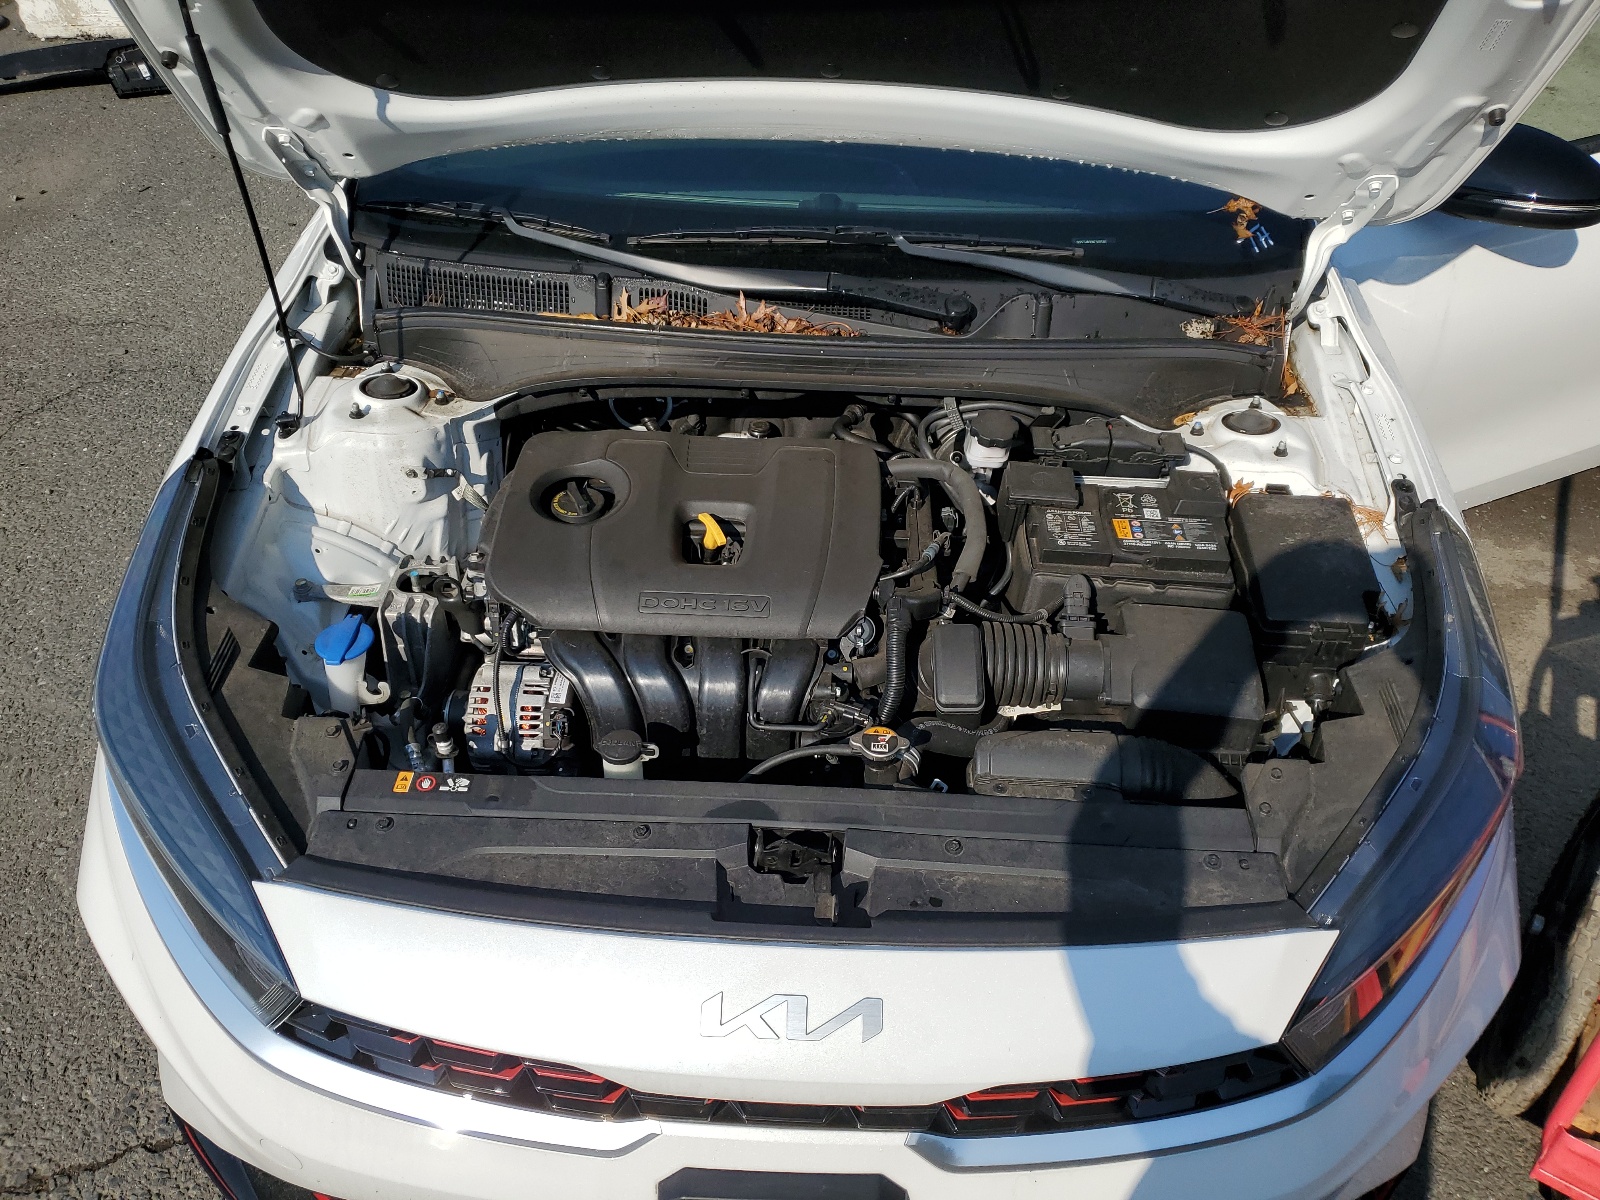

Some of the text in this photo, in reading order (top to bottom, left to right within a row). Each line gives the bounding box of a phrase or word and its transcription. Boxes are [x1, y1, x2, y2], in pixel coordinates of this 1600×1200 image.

[640, 597, 769, 613] DOHC 16V
[700, 991, 884, 1043] KIA
